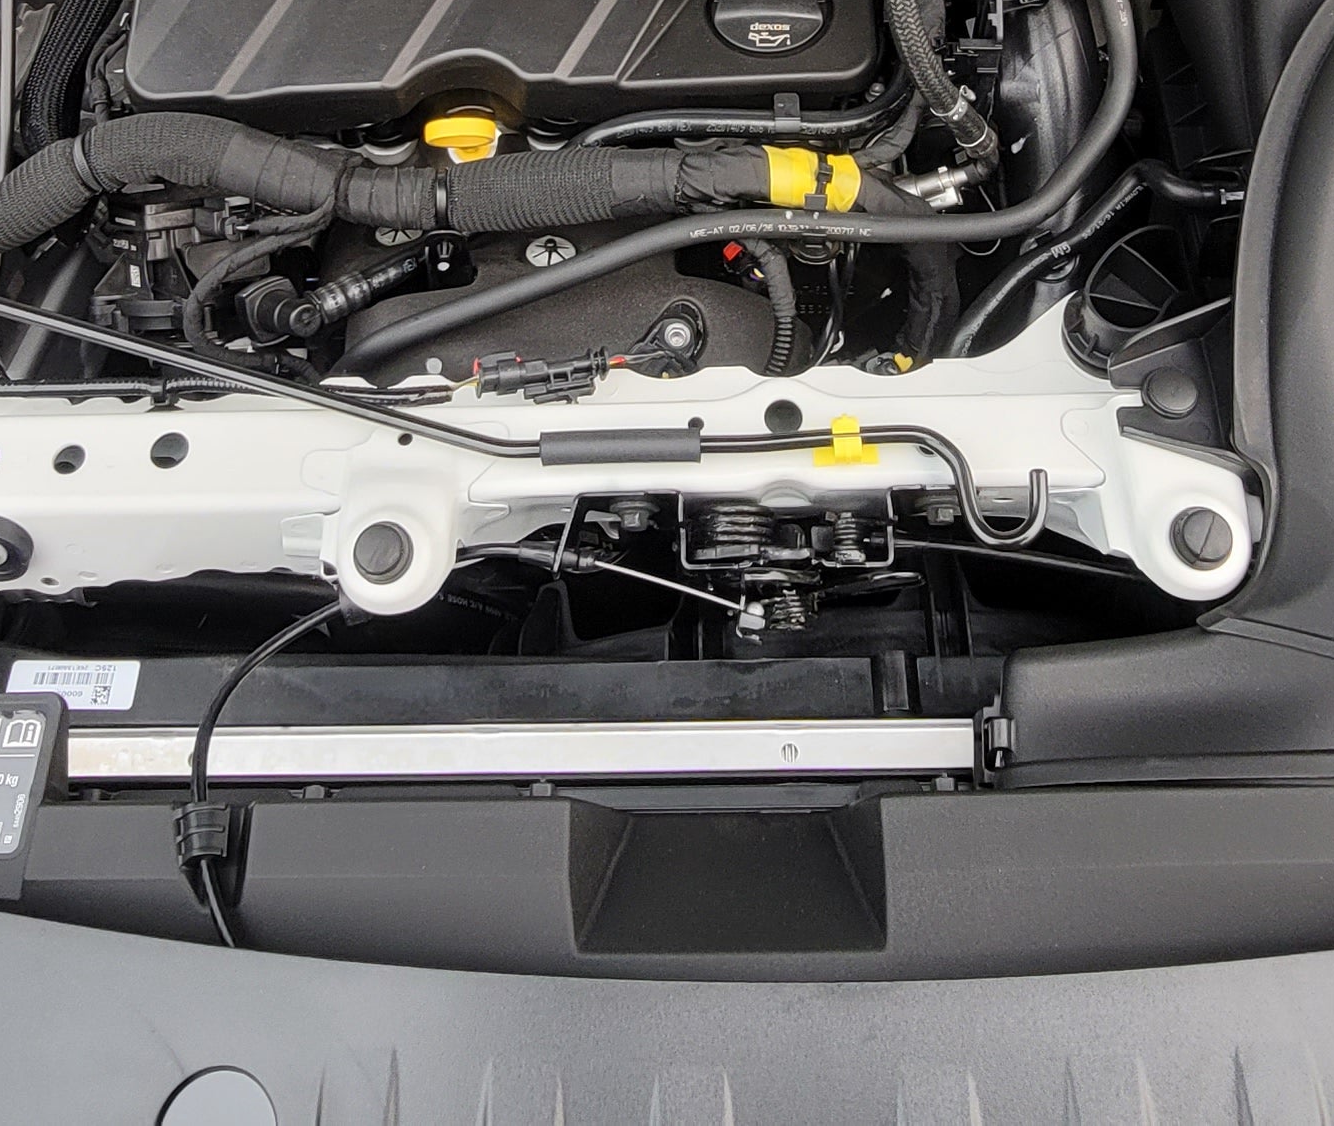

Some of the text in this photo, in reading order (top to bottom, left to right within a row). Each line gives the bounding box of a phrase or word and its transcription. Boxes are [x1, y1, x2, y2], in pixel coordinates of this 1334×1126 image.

[749, 22, 791, 31] dexos
[1051, 241, 1071, 259] GM
[5, 773, 19, 788] kg
